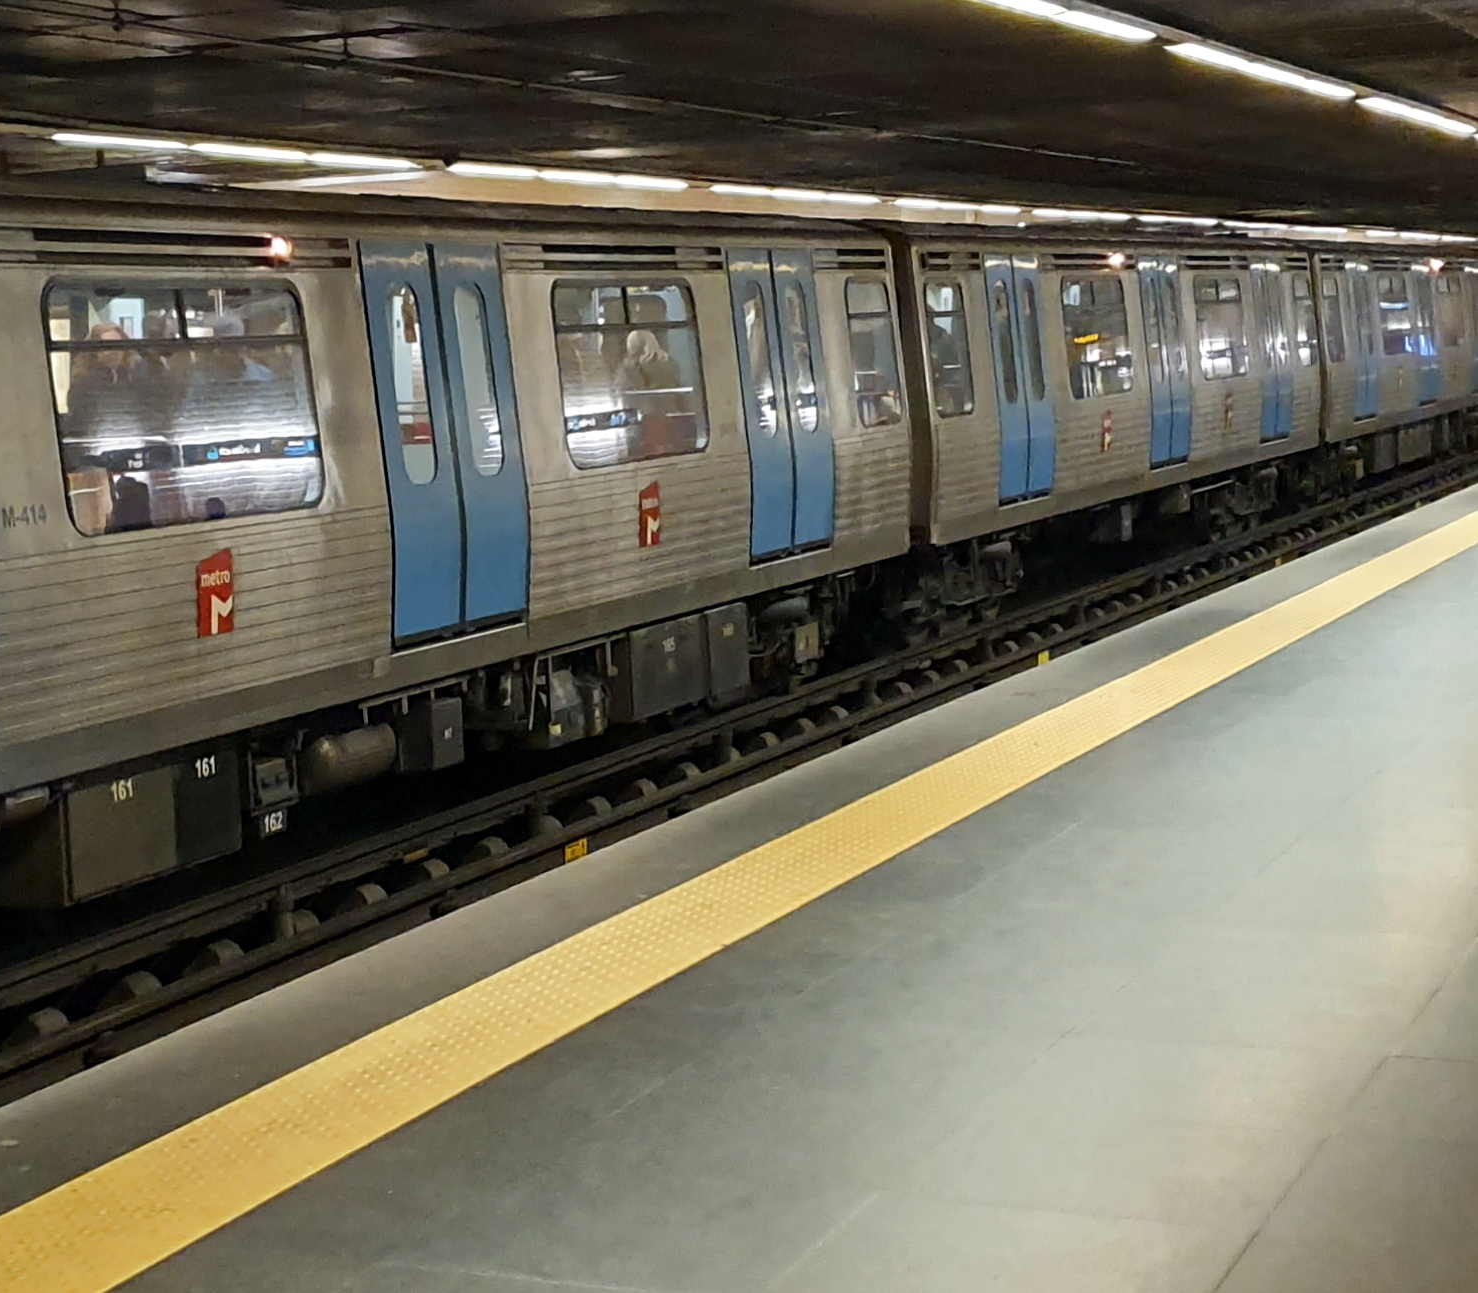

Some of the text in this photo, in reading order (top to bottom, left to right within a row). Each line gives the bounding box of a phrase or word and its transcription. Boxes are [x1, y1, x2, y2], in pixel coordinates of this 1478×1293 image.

[1, 503, 48, 529] M-414
[200, 569, 231, 588] metro
[194, 755, 217, 779] 161
[110, 778, 135, 803] 161
[263, 811, 284, 834] 162
